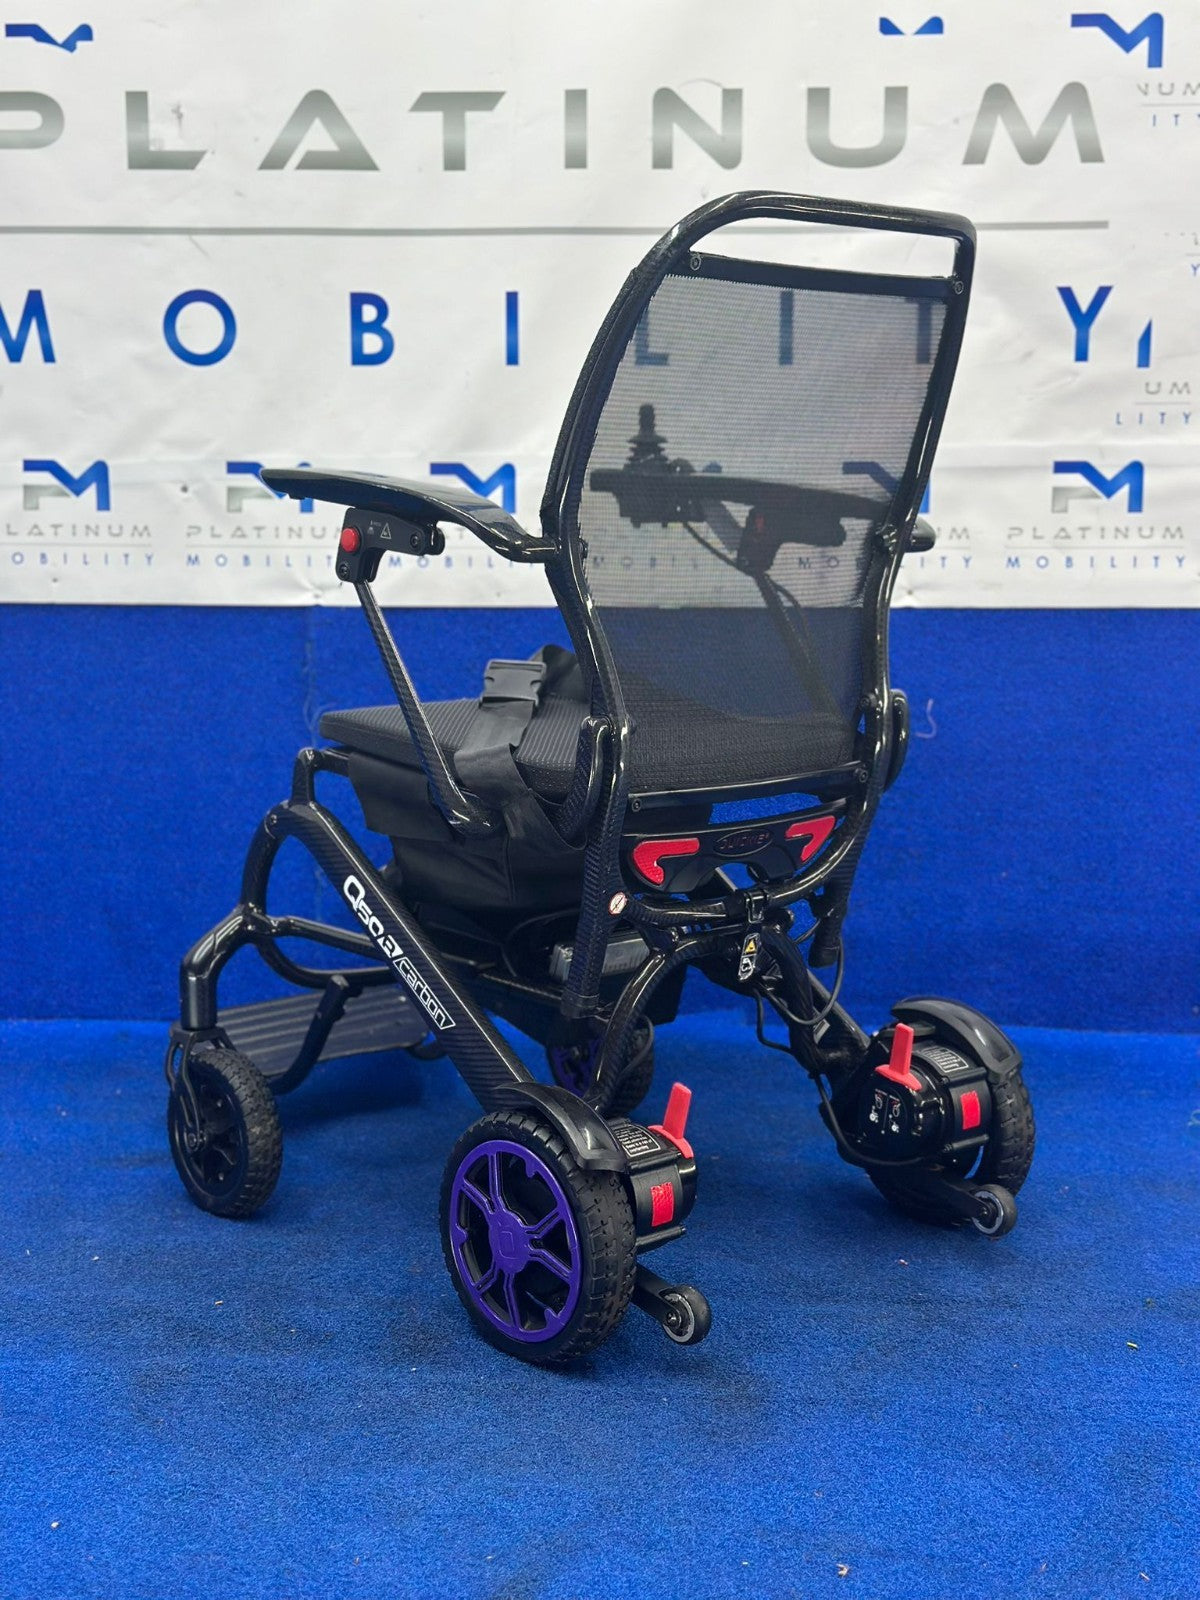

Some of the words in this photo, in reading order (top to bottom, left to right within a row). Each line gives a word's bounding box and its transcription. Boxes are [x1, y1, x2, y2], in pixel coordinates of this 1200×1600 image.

[0, 82, 1105, 170] PLATINUM
[187, 525, 340, 540] PLATINU
[1007, 526, 1184, 540] PLATINUM
[187, 554, 333, 568] MOBILIT
[389, 555, 535, 569] MOBIL
[1006, 556, 1185, 569] MOBILITY
[398, 959, 448, 1027] carbon
